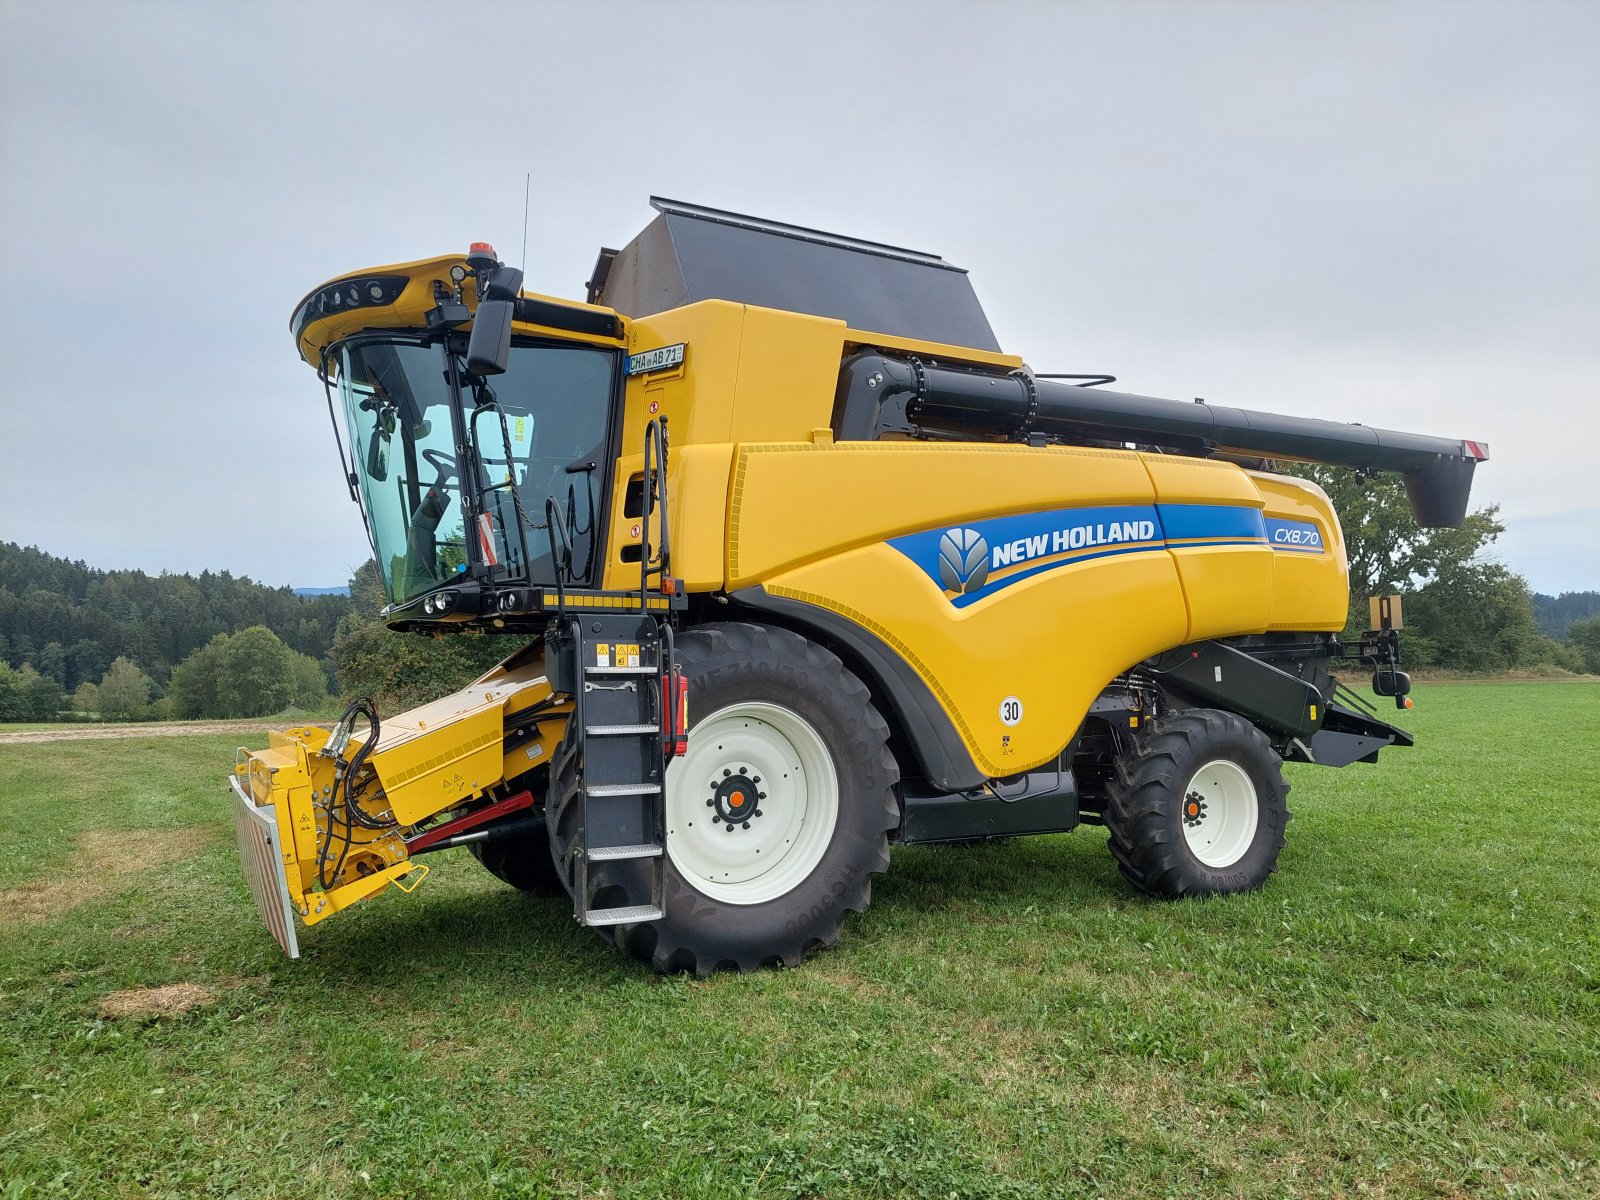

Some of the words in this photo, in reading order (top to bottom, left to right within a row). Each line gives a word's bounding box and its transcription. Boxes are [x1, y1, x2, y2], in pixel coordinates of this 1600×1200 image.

[630, 355, 646, 370] CHA
[652, 351, 664, 365] AB
[665, 348, 676, 361] 71
[993, 534, 1049, 568] NEW
[1053, 521, 1154, 552] HOLLAND
[1274, 528, 1319, 545] CX8.70
[1004, 702, 1018, 721] 30
